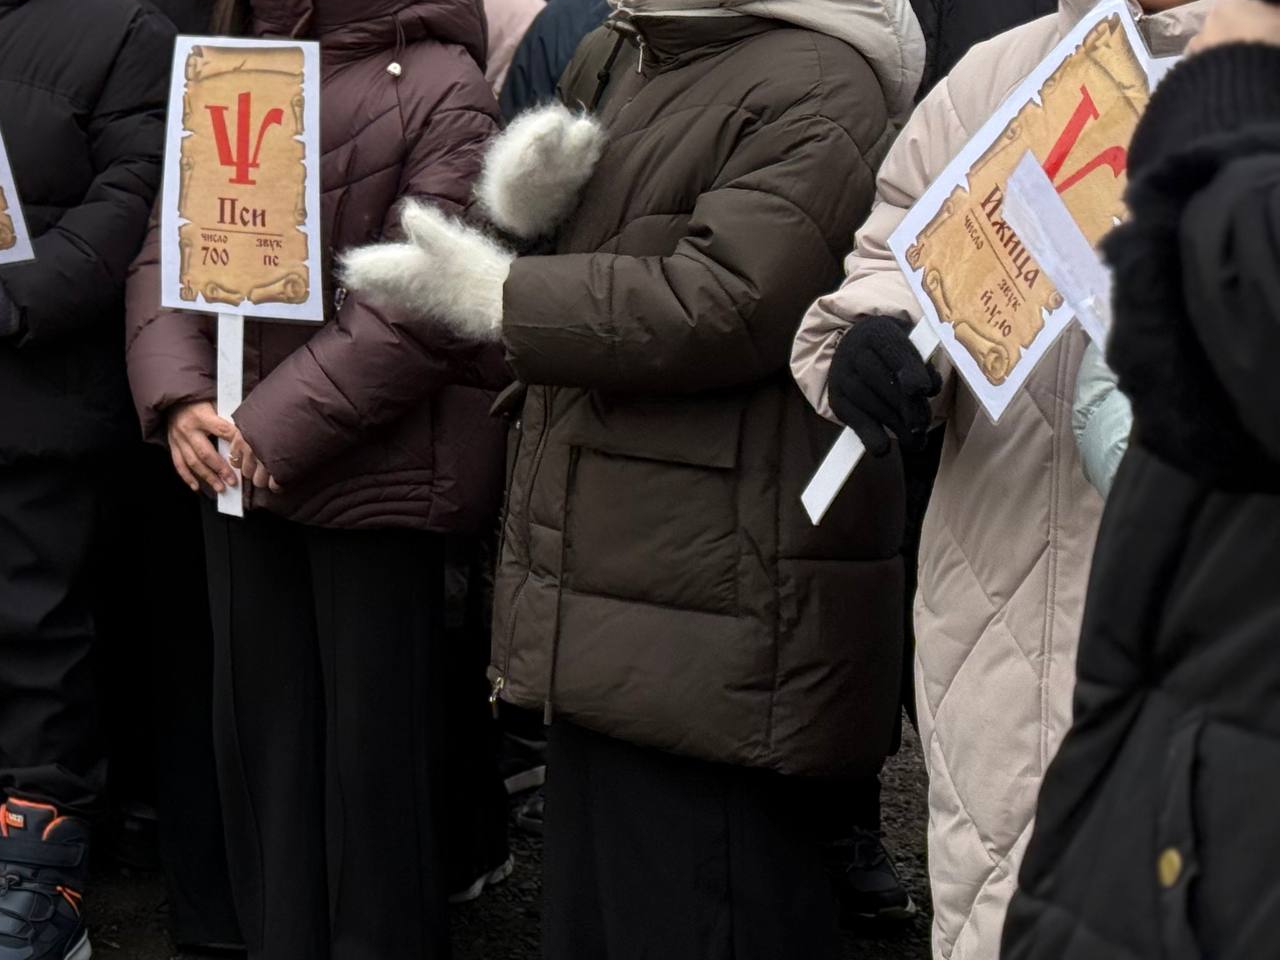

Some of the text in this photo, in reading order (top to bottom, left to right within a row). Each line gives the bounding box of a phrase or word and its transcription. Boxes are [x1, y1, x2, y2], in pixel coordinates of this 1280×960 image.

[217, 197, 267, 228] Пси
[200, 233, 282, 251] число звук
[201, 246, 280, 267] 700 пс
[964, 214, 1022, 312] число звук
